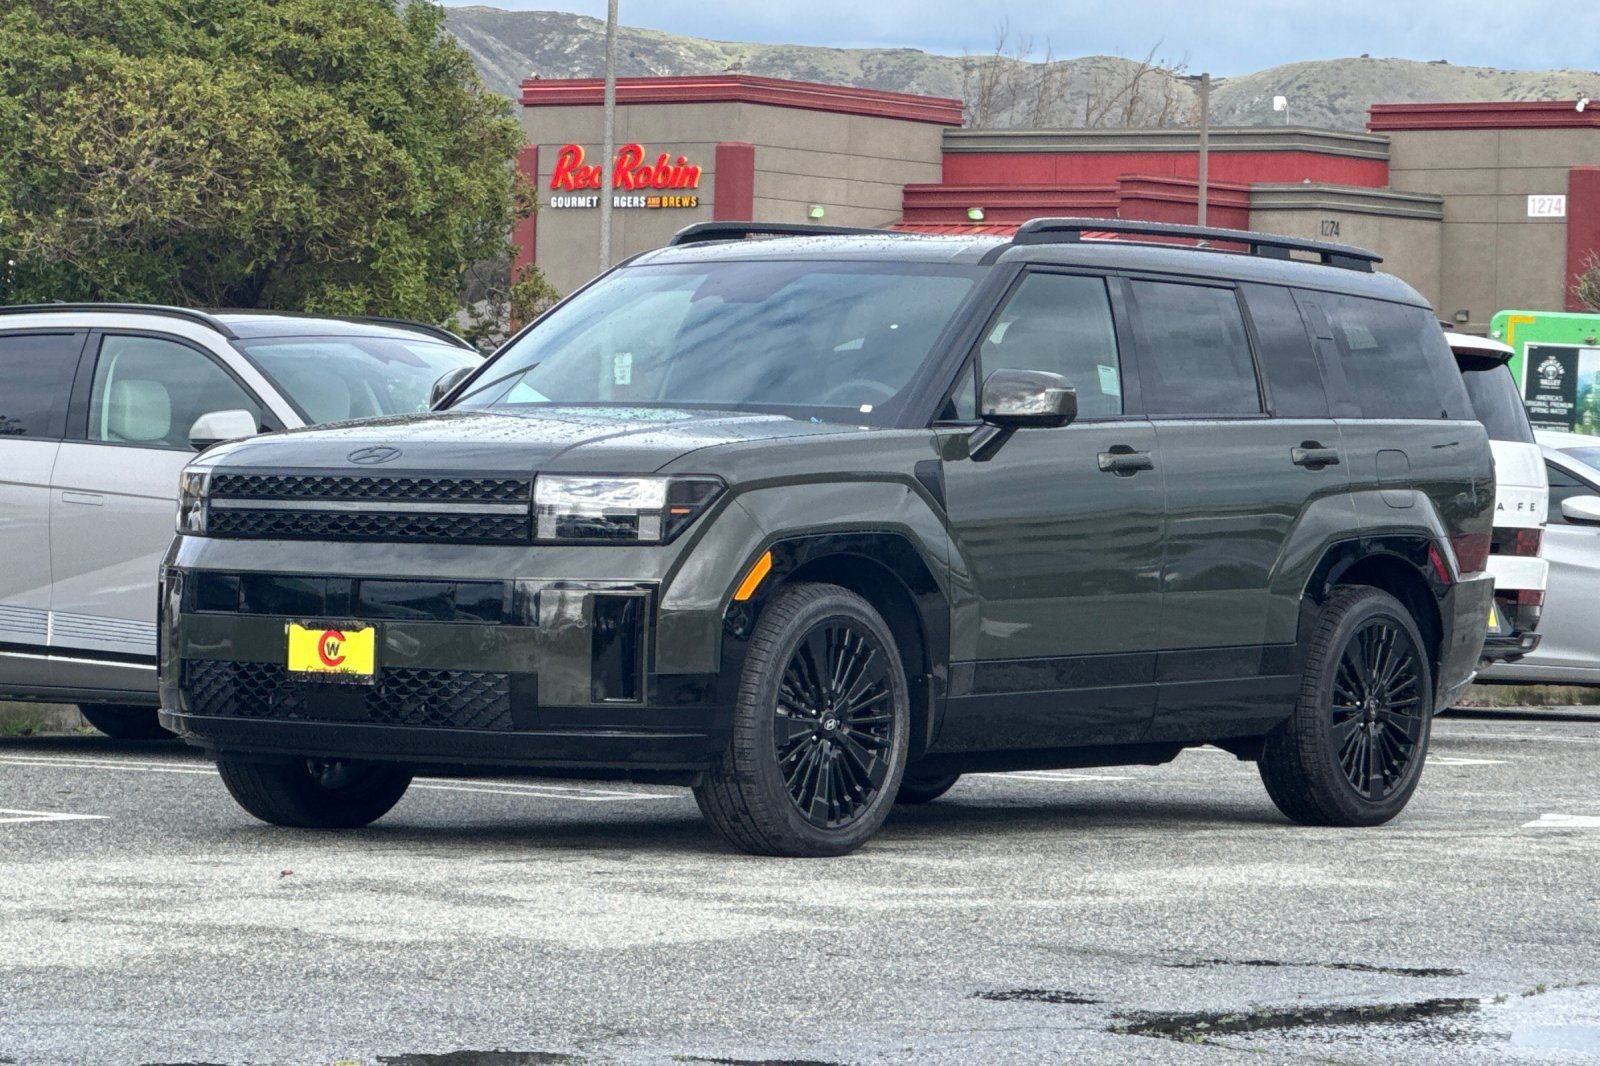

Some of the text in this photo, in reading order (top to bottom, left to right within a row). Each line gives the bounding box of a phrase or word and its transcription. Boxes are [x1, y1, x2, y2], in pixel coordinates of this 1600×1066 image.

[613, 144, 701, 190] Robin
[551, 196, 598, 207] GOURMET
[613, 196, 645, 207] RGERS
[662, 197, 697, 207] BREWS
[1532, 199, 1562, 214] 1274
[1320, 220, 1340, 237] 1274
[1516, 502, 1536, 512] FE
[326, 642, 340, 657] W
